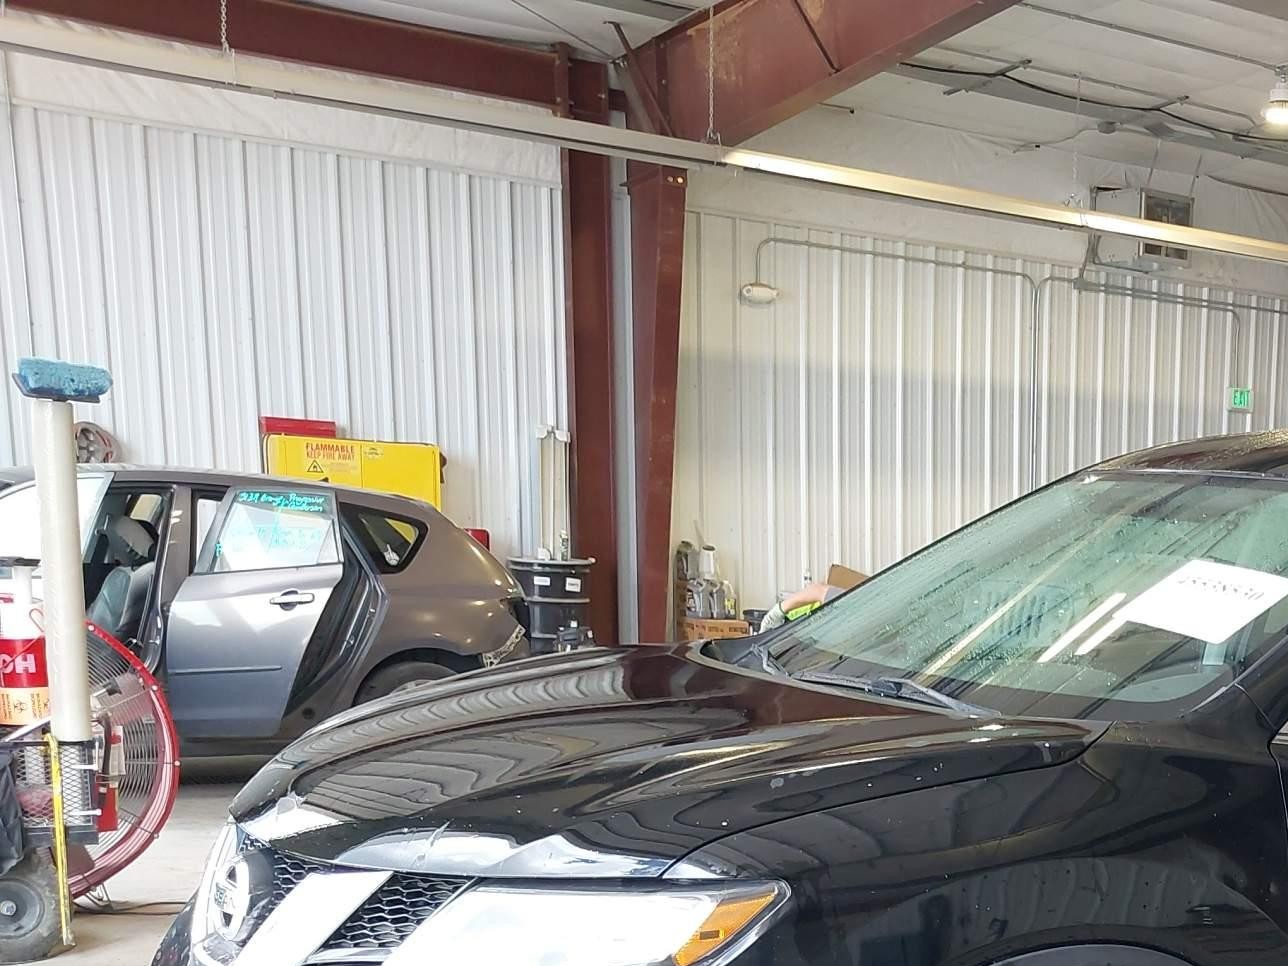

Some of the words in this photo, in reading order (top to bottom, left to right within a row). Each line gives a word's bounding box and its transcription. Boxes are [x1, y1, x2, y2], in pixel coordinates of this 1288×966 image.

[1233, 390, 1249, 406] EXIT
[305, 442, 355, 454] FLAMMABLE
[306, 451, 322, 460] KEEP
[323, 452, 336, 461] FIRE
[337, 453, 356, 462] AWAY
